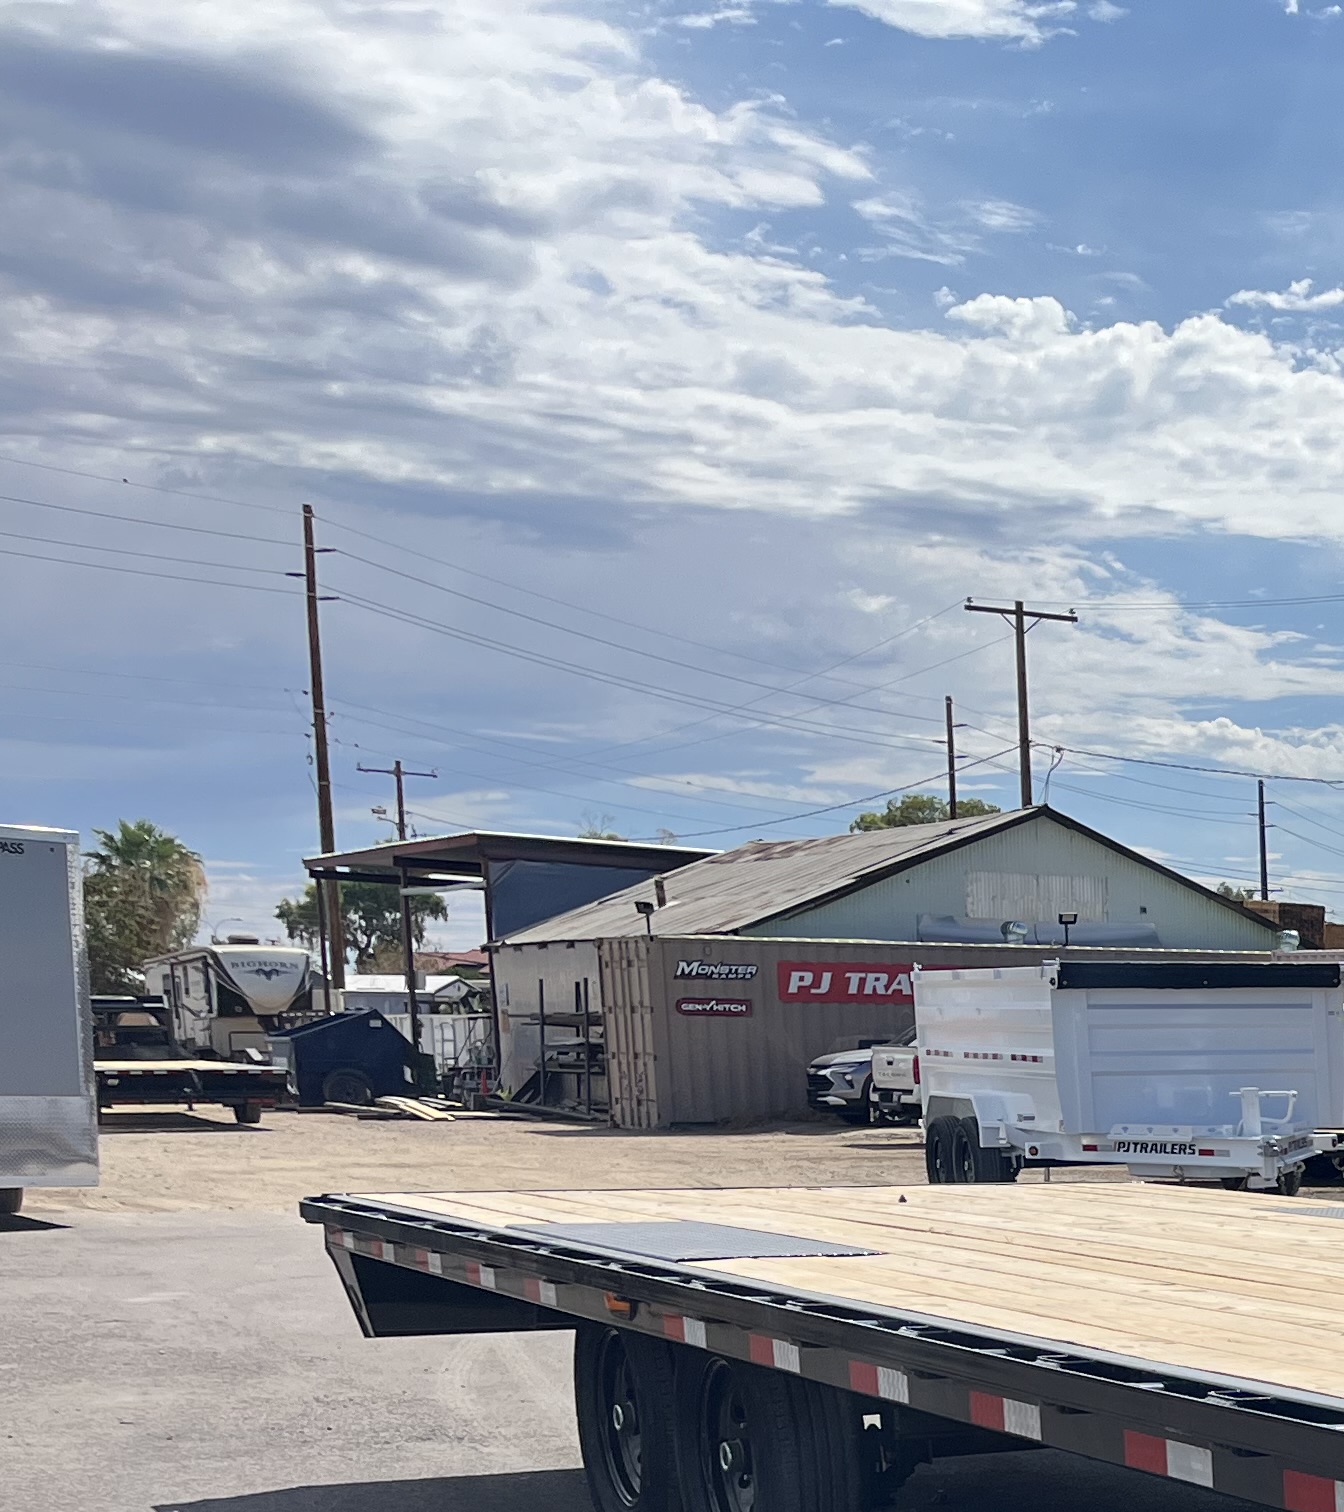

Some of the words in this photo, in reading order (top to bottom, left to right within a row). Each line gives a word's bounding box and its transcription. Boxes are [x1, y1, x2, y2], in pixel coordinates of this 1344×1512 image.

[230, 961, 299, 969] BIGHORN
[787, 971, 833, 994] PJ
[844, 972, 913, 995] TRA
